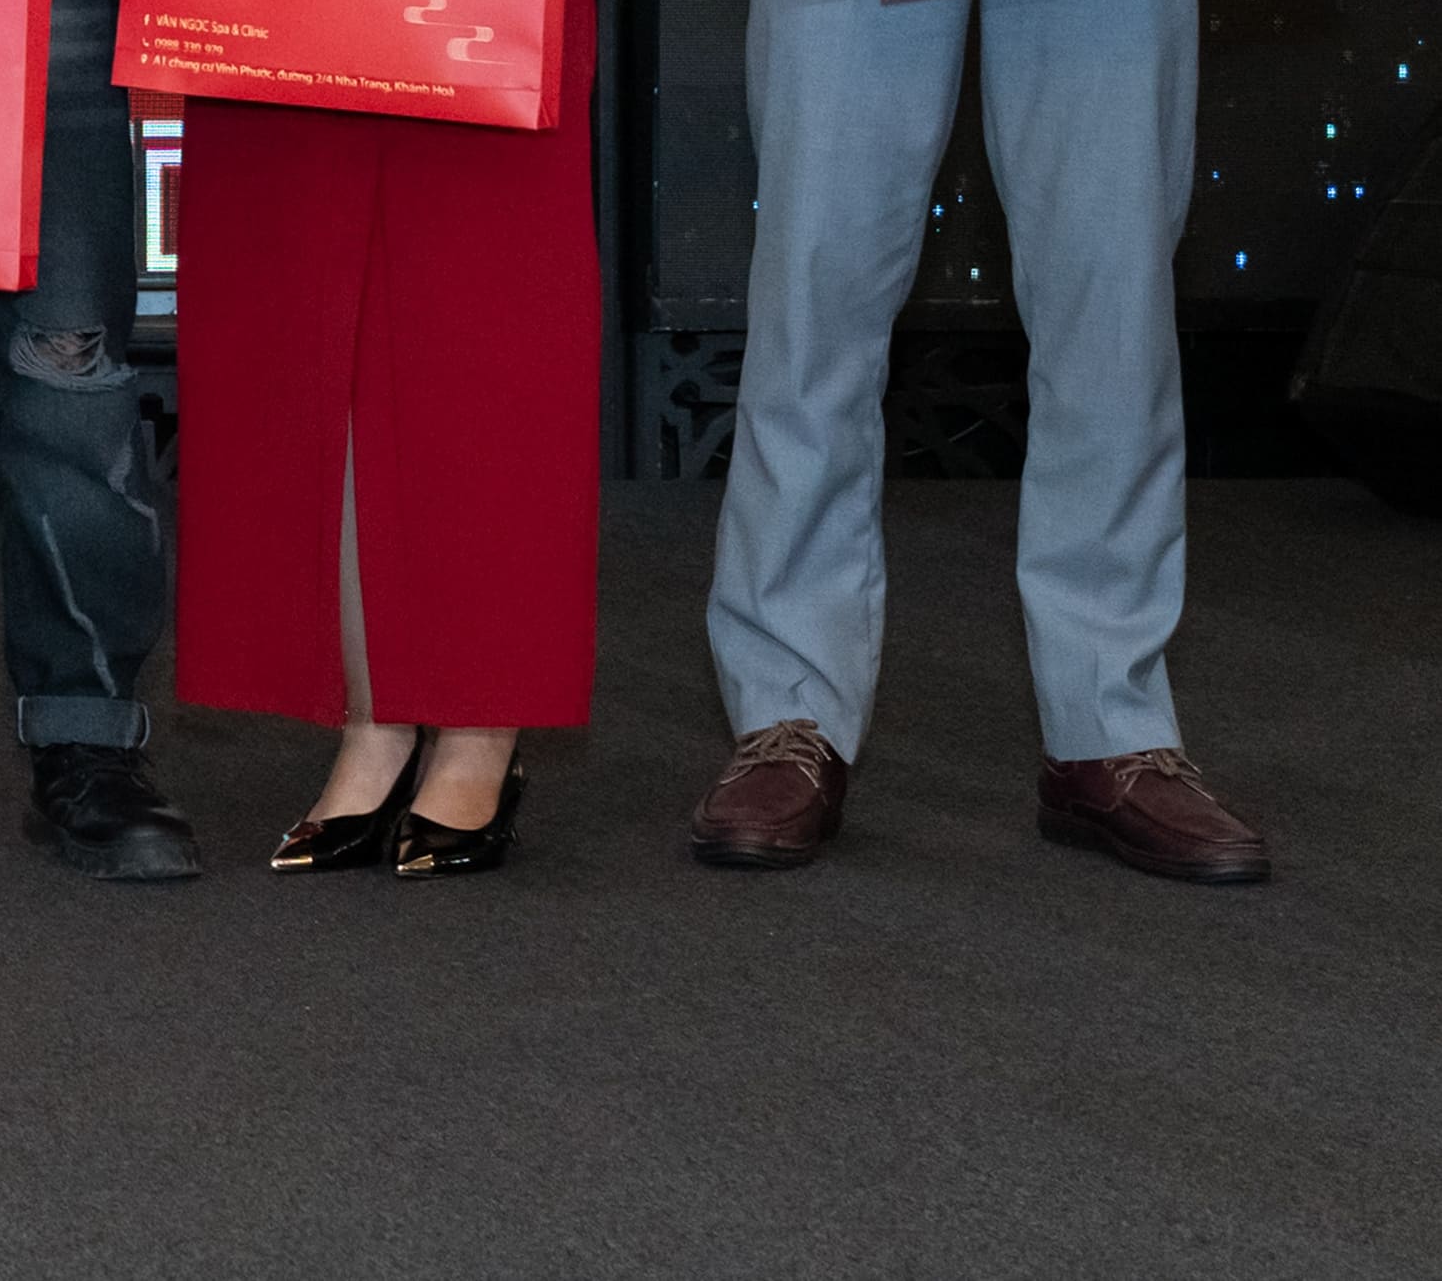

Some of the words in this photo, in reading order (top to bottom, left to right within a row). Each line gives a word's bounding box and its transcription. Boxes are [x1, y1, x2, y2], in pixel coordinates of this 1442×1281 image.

[211, 20, 230, 35] Spa
[230, 23, 239, 36] &
[240, 23, 269, 39] Clinic
